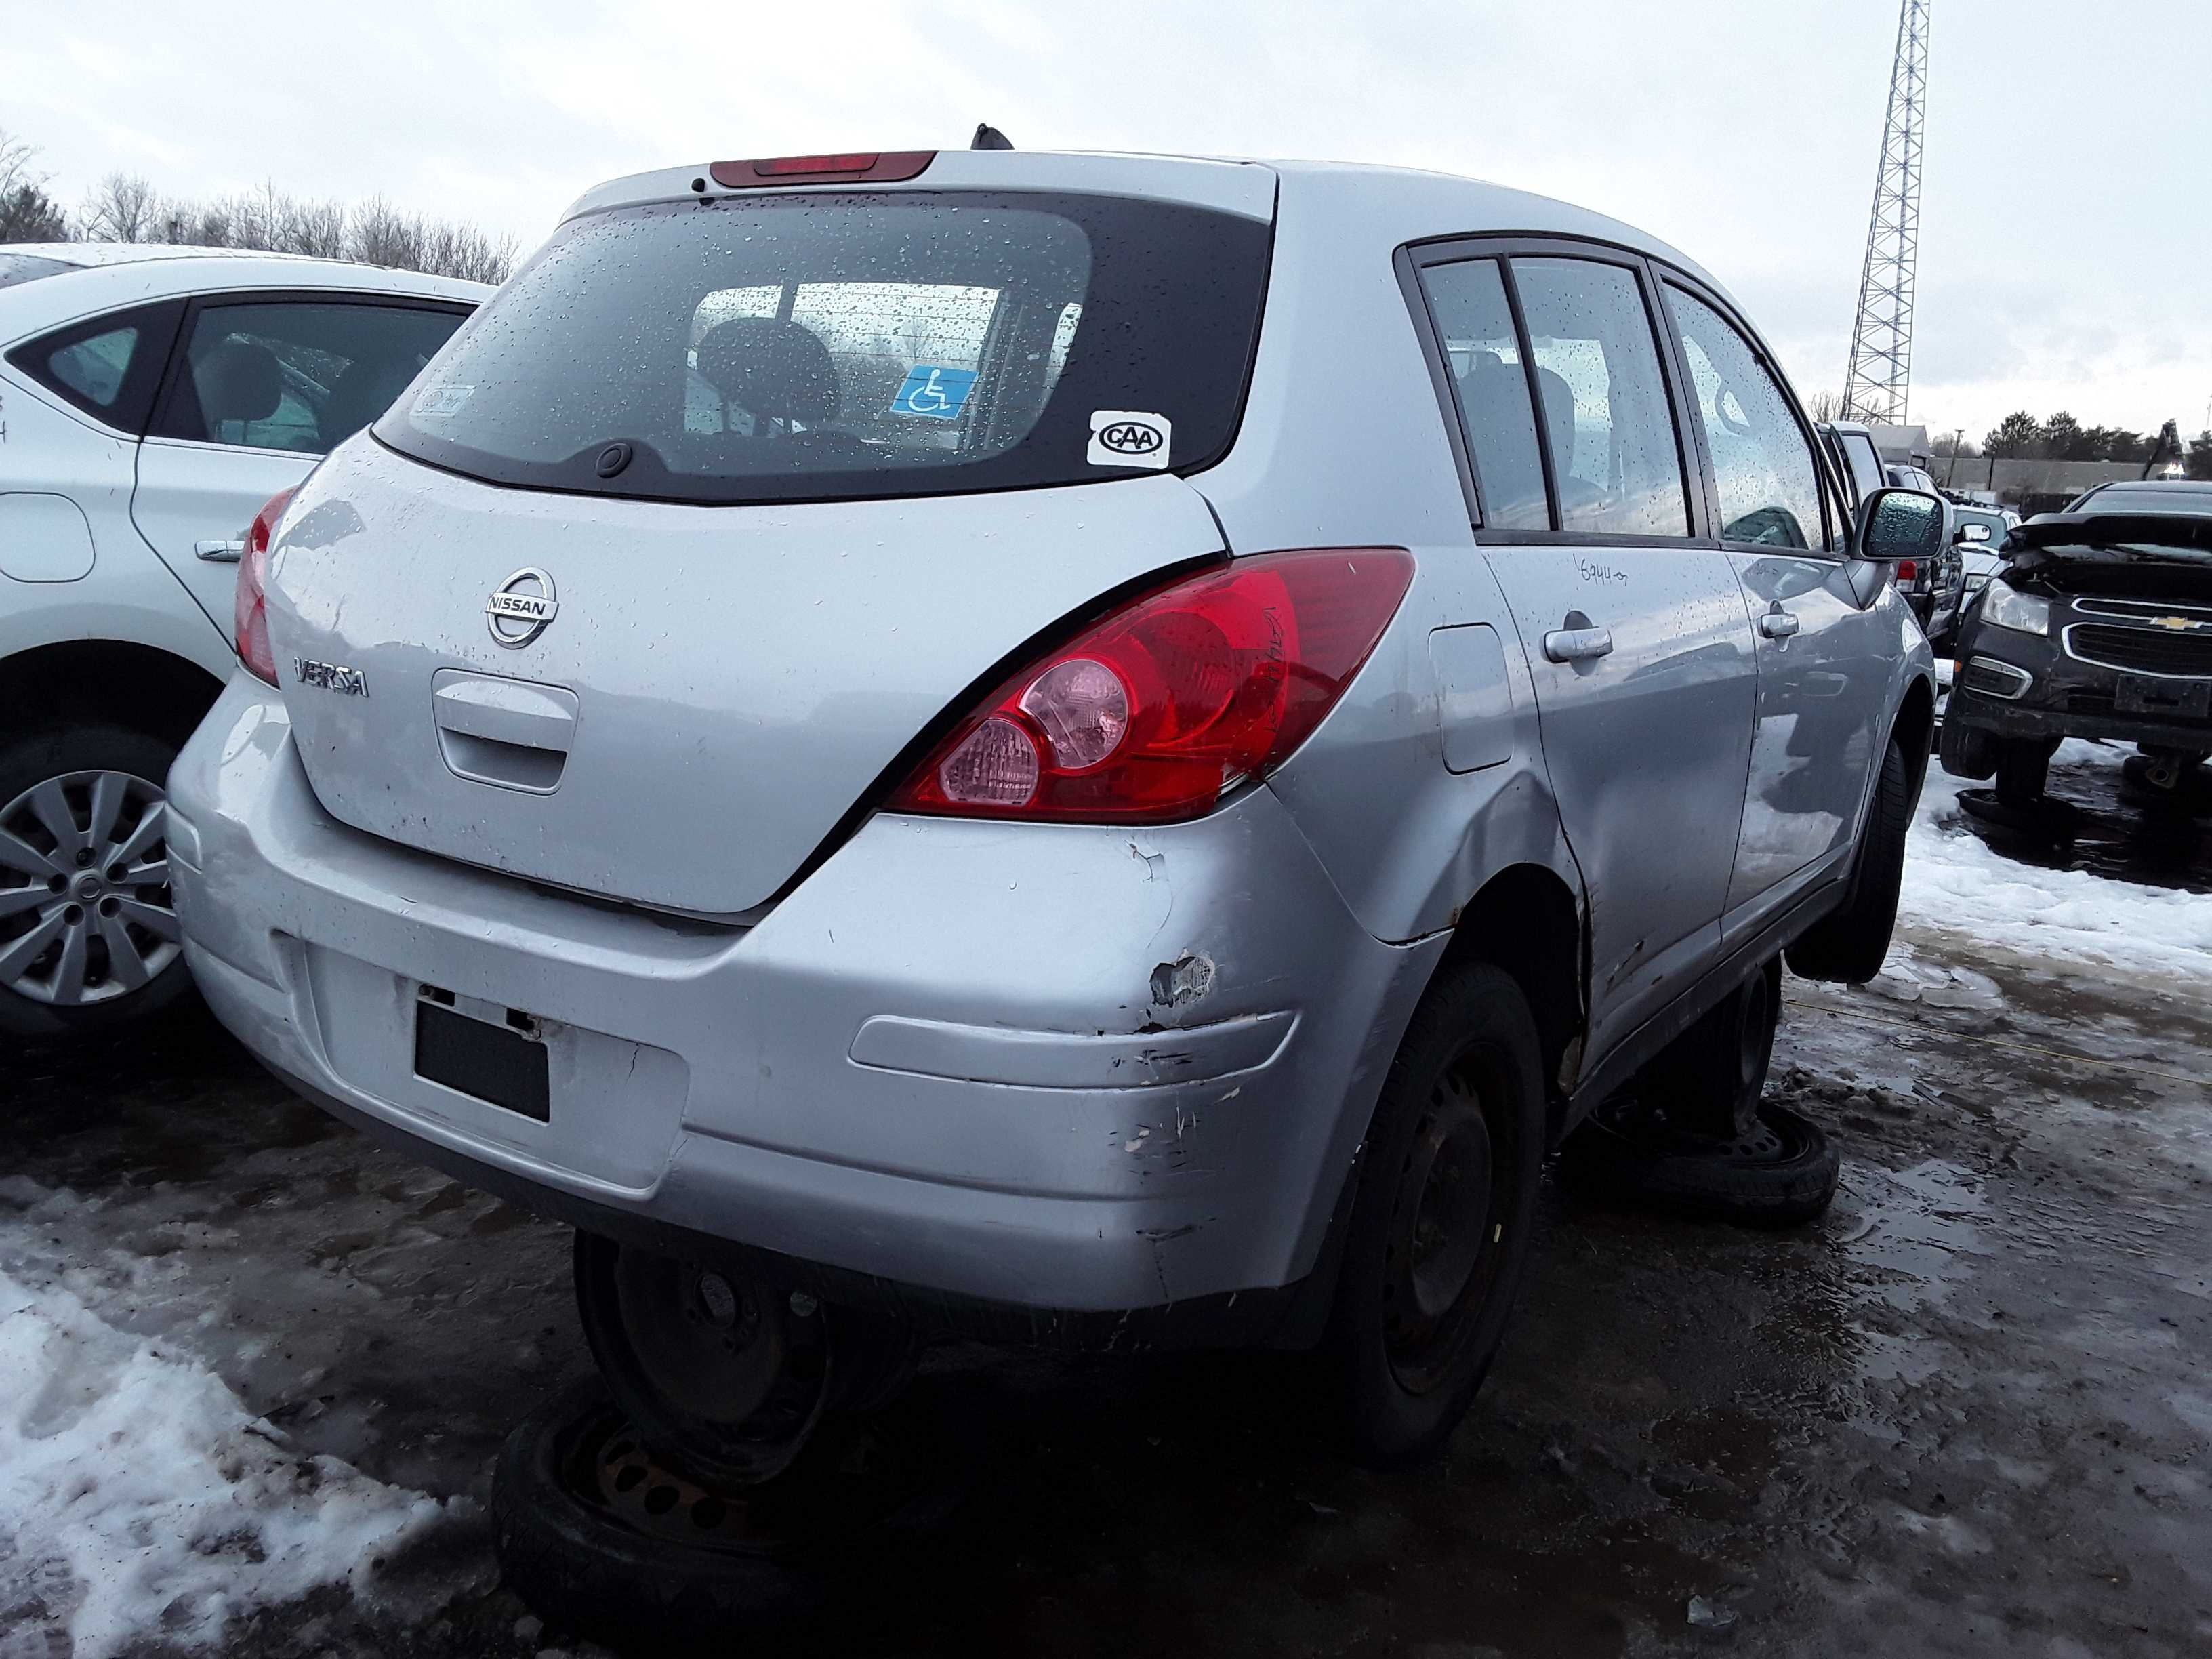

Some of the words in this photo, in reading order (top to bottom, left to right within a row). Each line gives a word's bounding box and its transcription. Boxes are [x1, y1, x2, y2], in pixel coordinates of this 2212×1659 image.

[1107, 426, 1153, 449] CAA
[489, 596, 546, 616] NISSAN
[293, 656, 369, 698] VERSA
